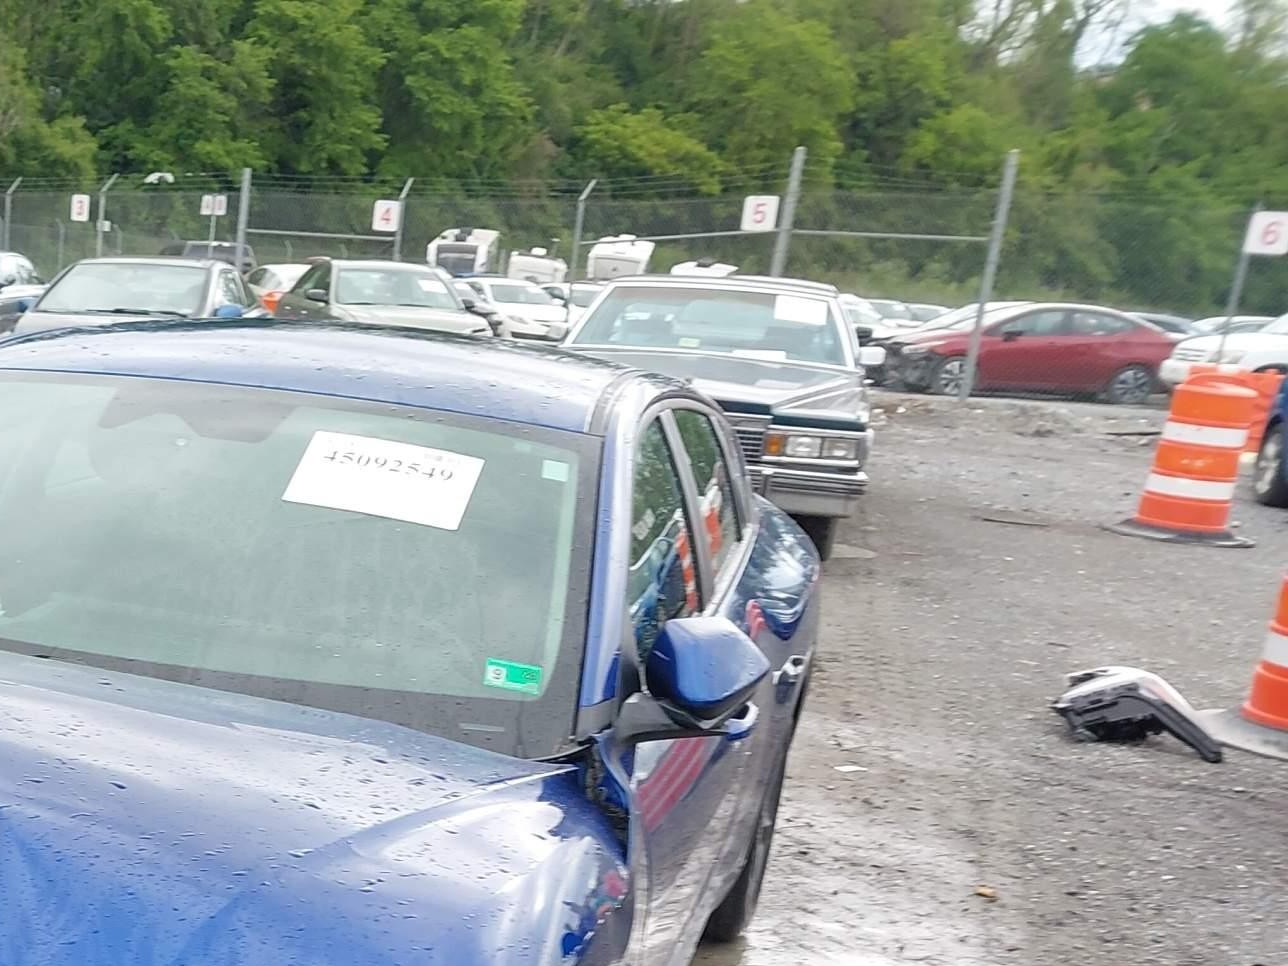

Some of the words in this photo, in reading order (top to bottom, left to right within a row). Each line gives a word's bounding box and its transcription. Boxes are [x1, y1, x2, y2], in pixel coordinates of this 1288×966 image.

[381, 207, 393, 225] 4
[753, 202, 767, 225] 5
[1261, 220, 1283, 247] 6
[323, 450, 454, 481] 45092549
